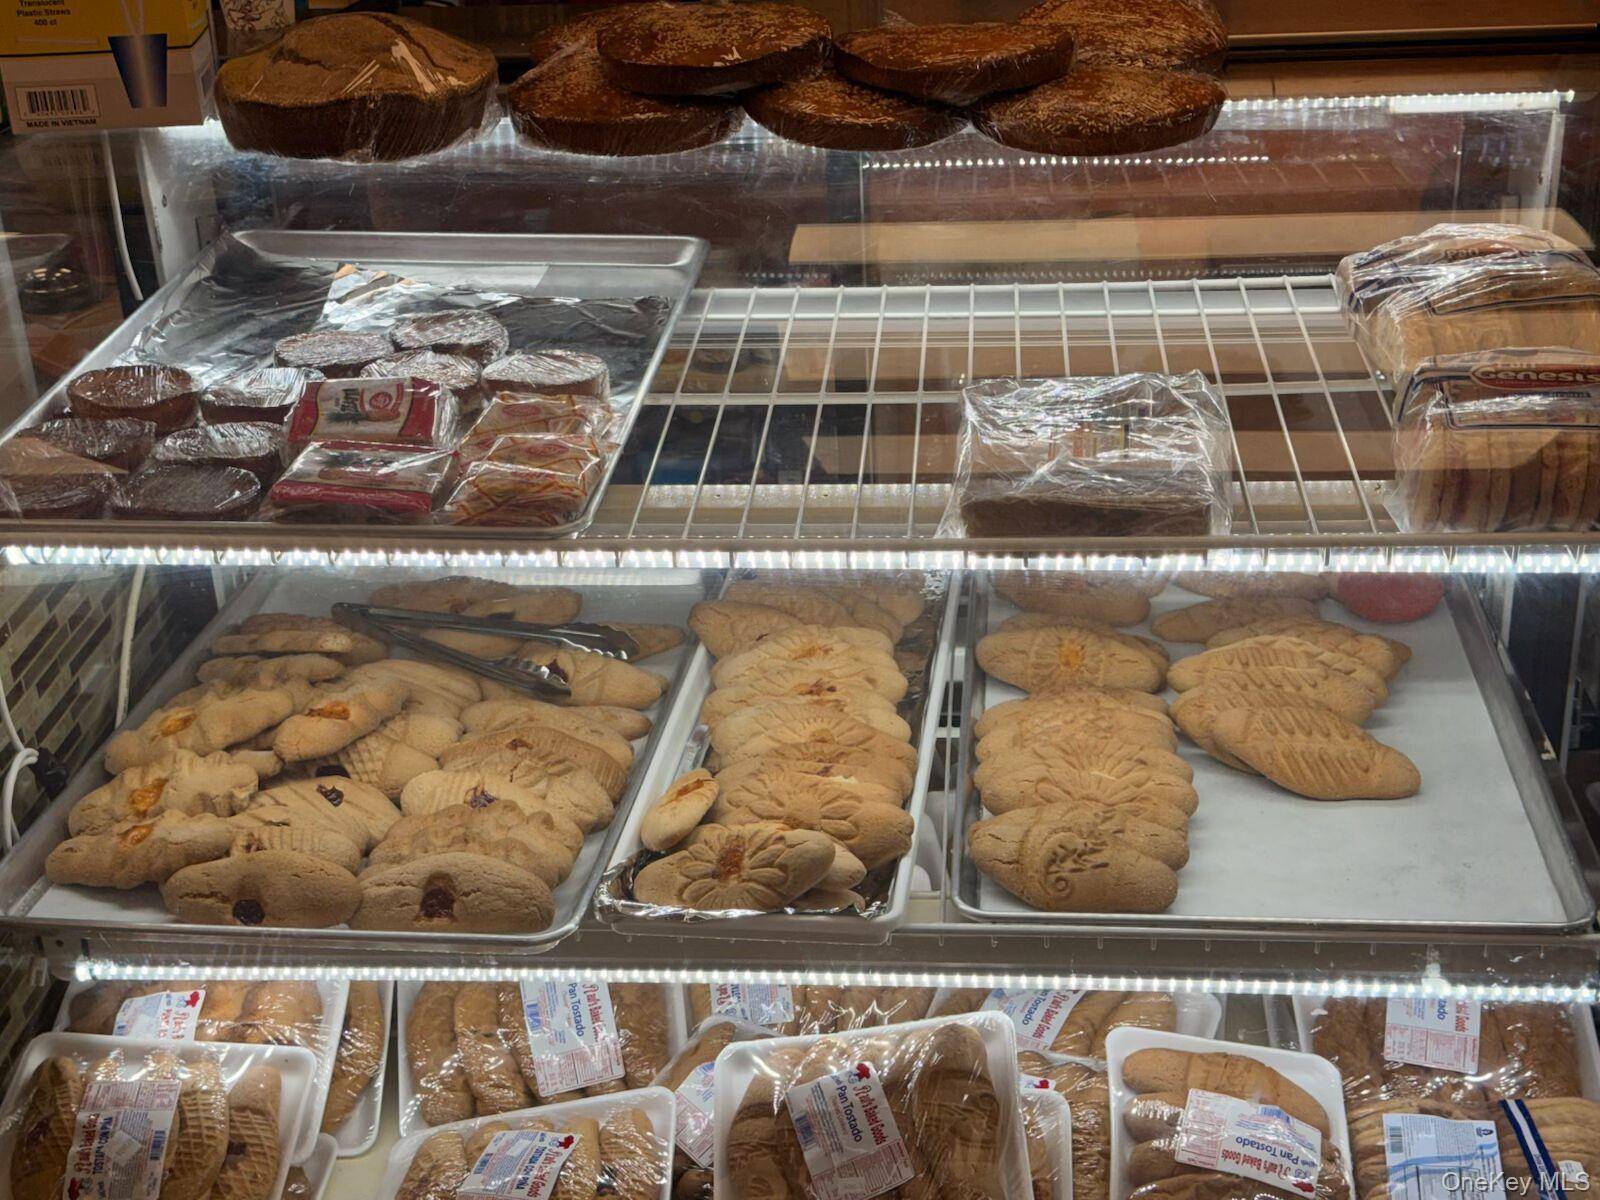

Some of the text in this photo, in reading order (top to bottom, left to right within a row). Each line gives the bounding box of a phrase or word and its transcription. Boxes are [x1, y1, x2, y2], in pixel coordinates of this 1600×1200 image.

[16, 9, 43, 17] Plastic
[26, 120, 49, 128] MADE
[61, 118, 97, 127] VIETNAM
[1475, 366, 1600, 382] Genesis
[568, 982, 586, 1036] Pan Tostado
[1022, 997, 1046, 1026] Tostado
[836, 1085, 849, 1103] Pan
[842, 1102, 865, 1142] Tostado
[1236, 1137, 1277, 1157] Tostado
[1221, 1149, 1241, 1165] Goods
[1280, 1150, 1299, 1164] Pan
